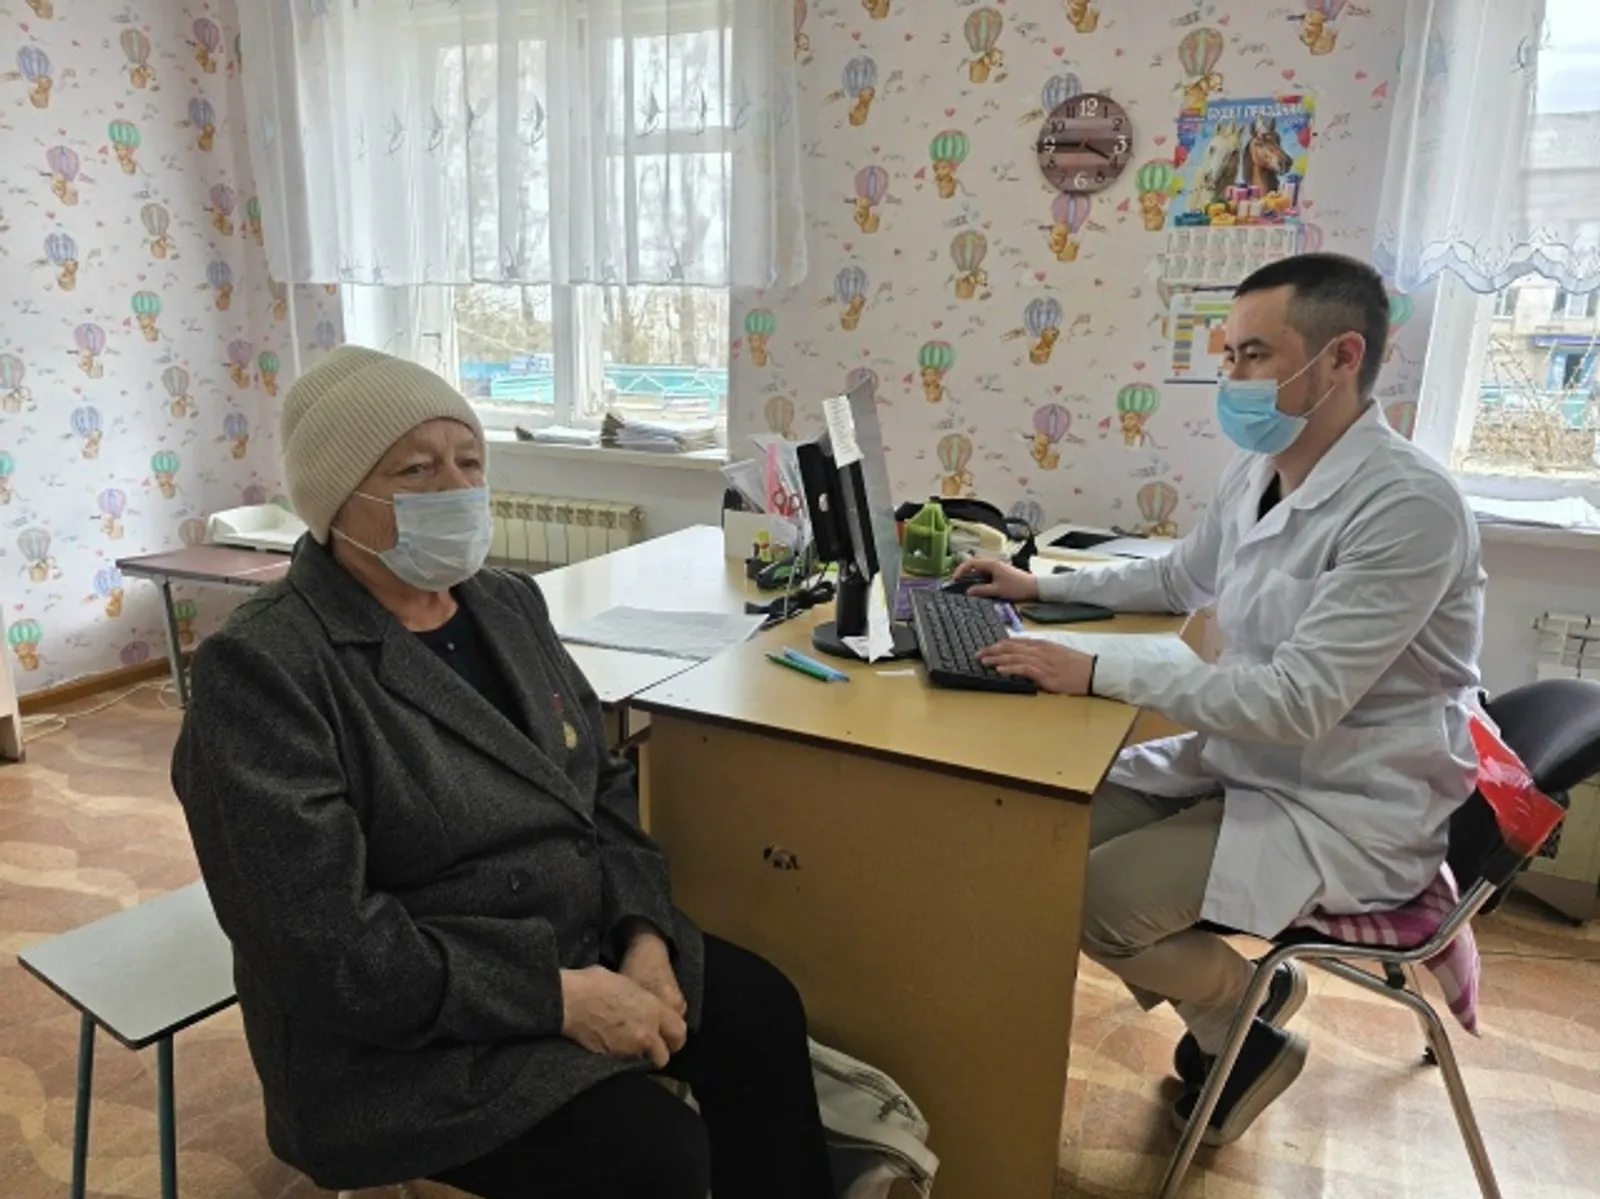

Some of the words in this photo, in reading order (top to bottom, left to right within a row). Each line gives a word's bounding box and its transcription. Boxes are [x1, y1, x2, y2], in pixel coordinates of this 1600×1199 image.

[1079, 98, 1098, 116] 12
[1051, 120, 1065, 134] 10
[1112, 118, 1123, 132] 2
[1113, 135, 1128, 154] 3
[1073, 171, 1088, 190] 6
